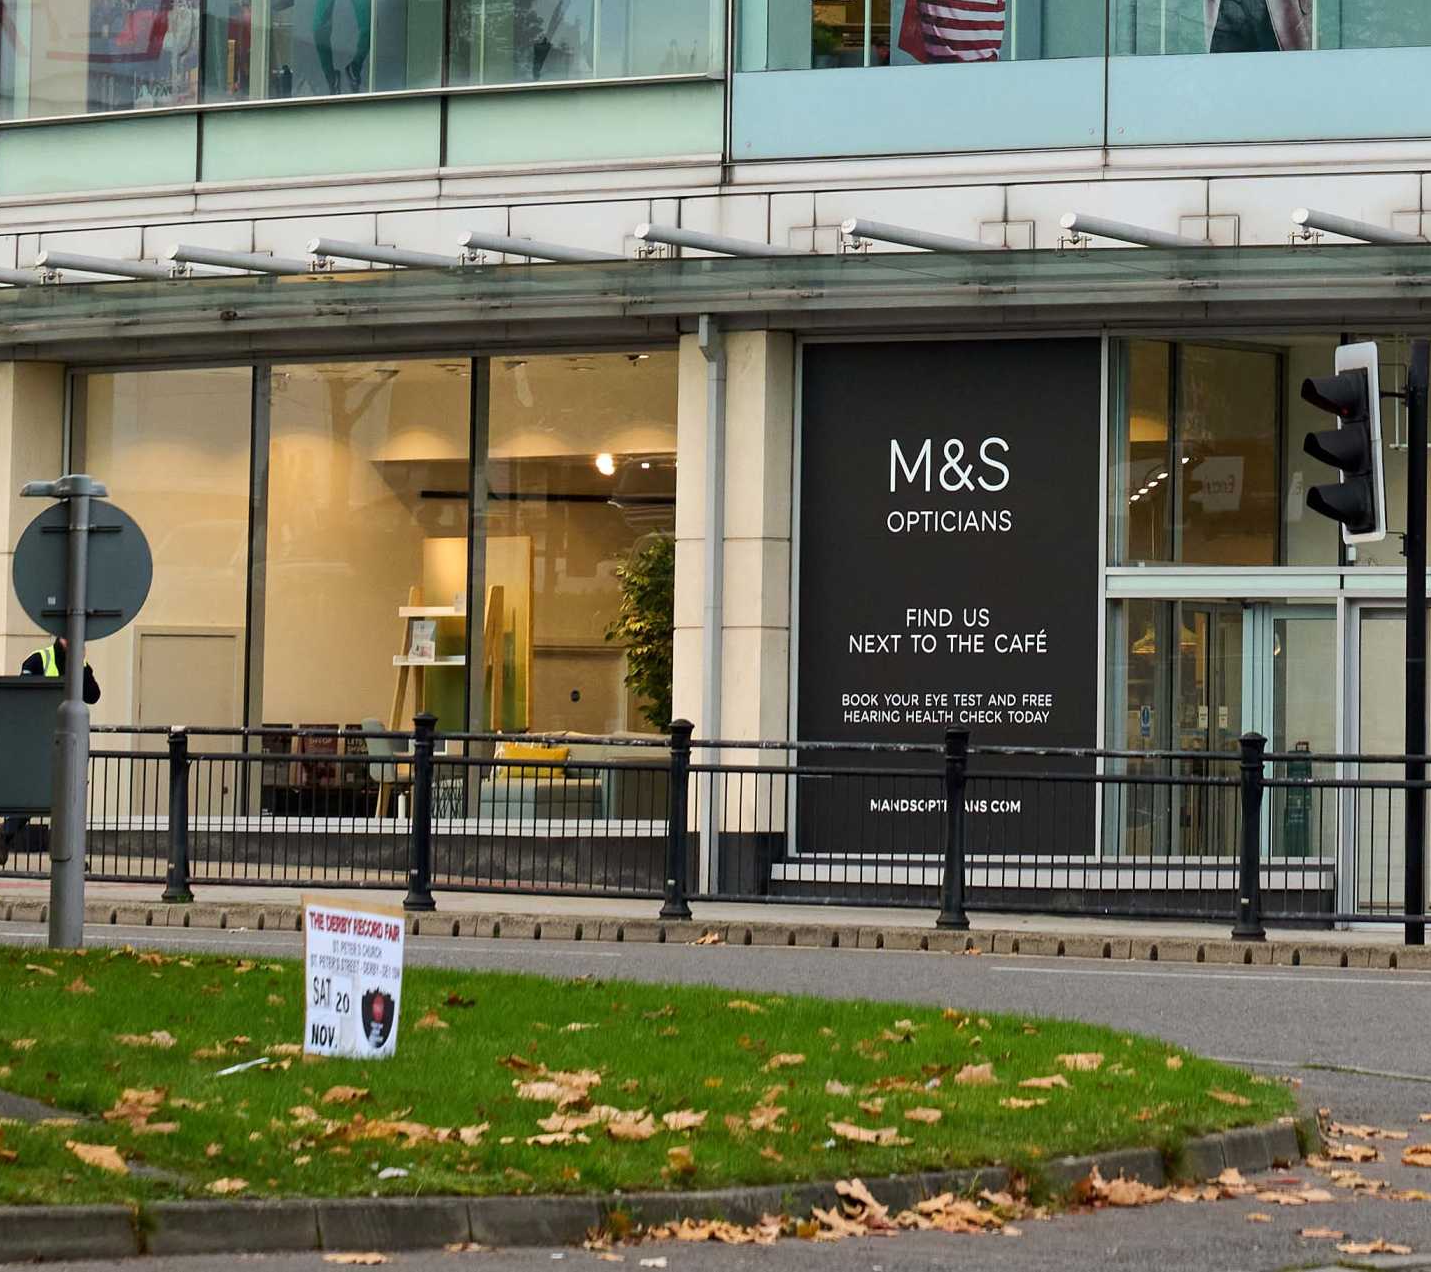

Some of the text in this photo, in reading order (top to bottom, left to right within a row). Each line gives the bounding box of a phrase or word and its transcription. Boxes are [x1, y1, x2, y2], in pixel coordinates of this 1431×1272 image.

[889, 437, 1010, 492] M&S
[886, 509, 1012, 533] OPTICIANS
[906, 608, 990, 627] FIND US
[849, 629, 1047, 653] NEXT TO THE CAFÉ
[842, 694, 1052, 706] BOOK YOUR EYE TEST AND FREE
[844, 711, 1050, 723] HEARING HEALTH CHECK TODAY
[870, 799, 1021, 813] MANDSOPTINSCOM
[309, 911, 400, 943] THE DERBY RECORD FAIR
[313, 975, 350, 1013] SAT 20
